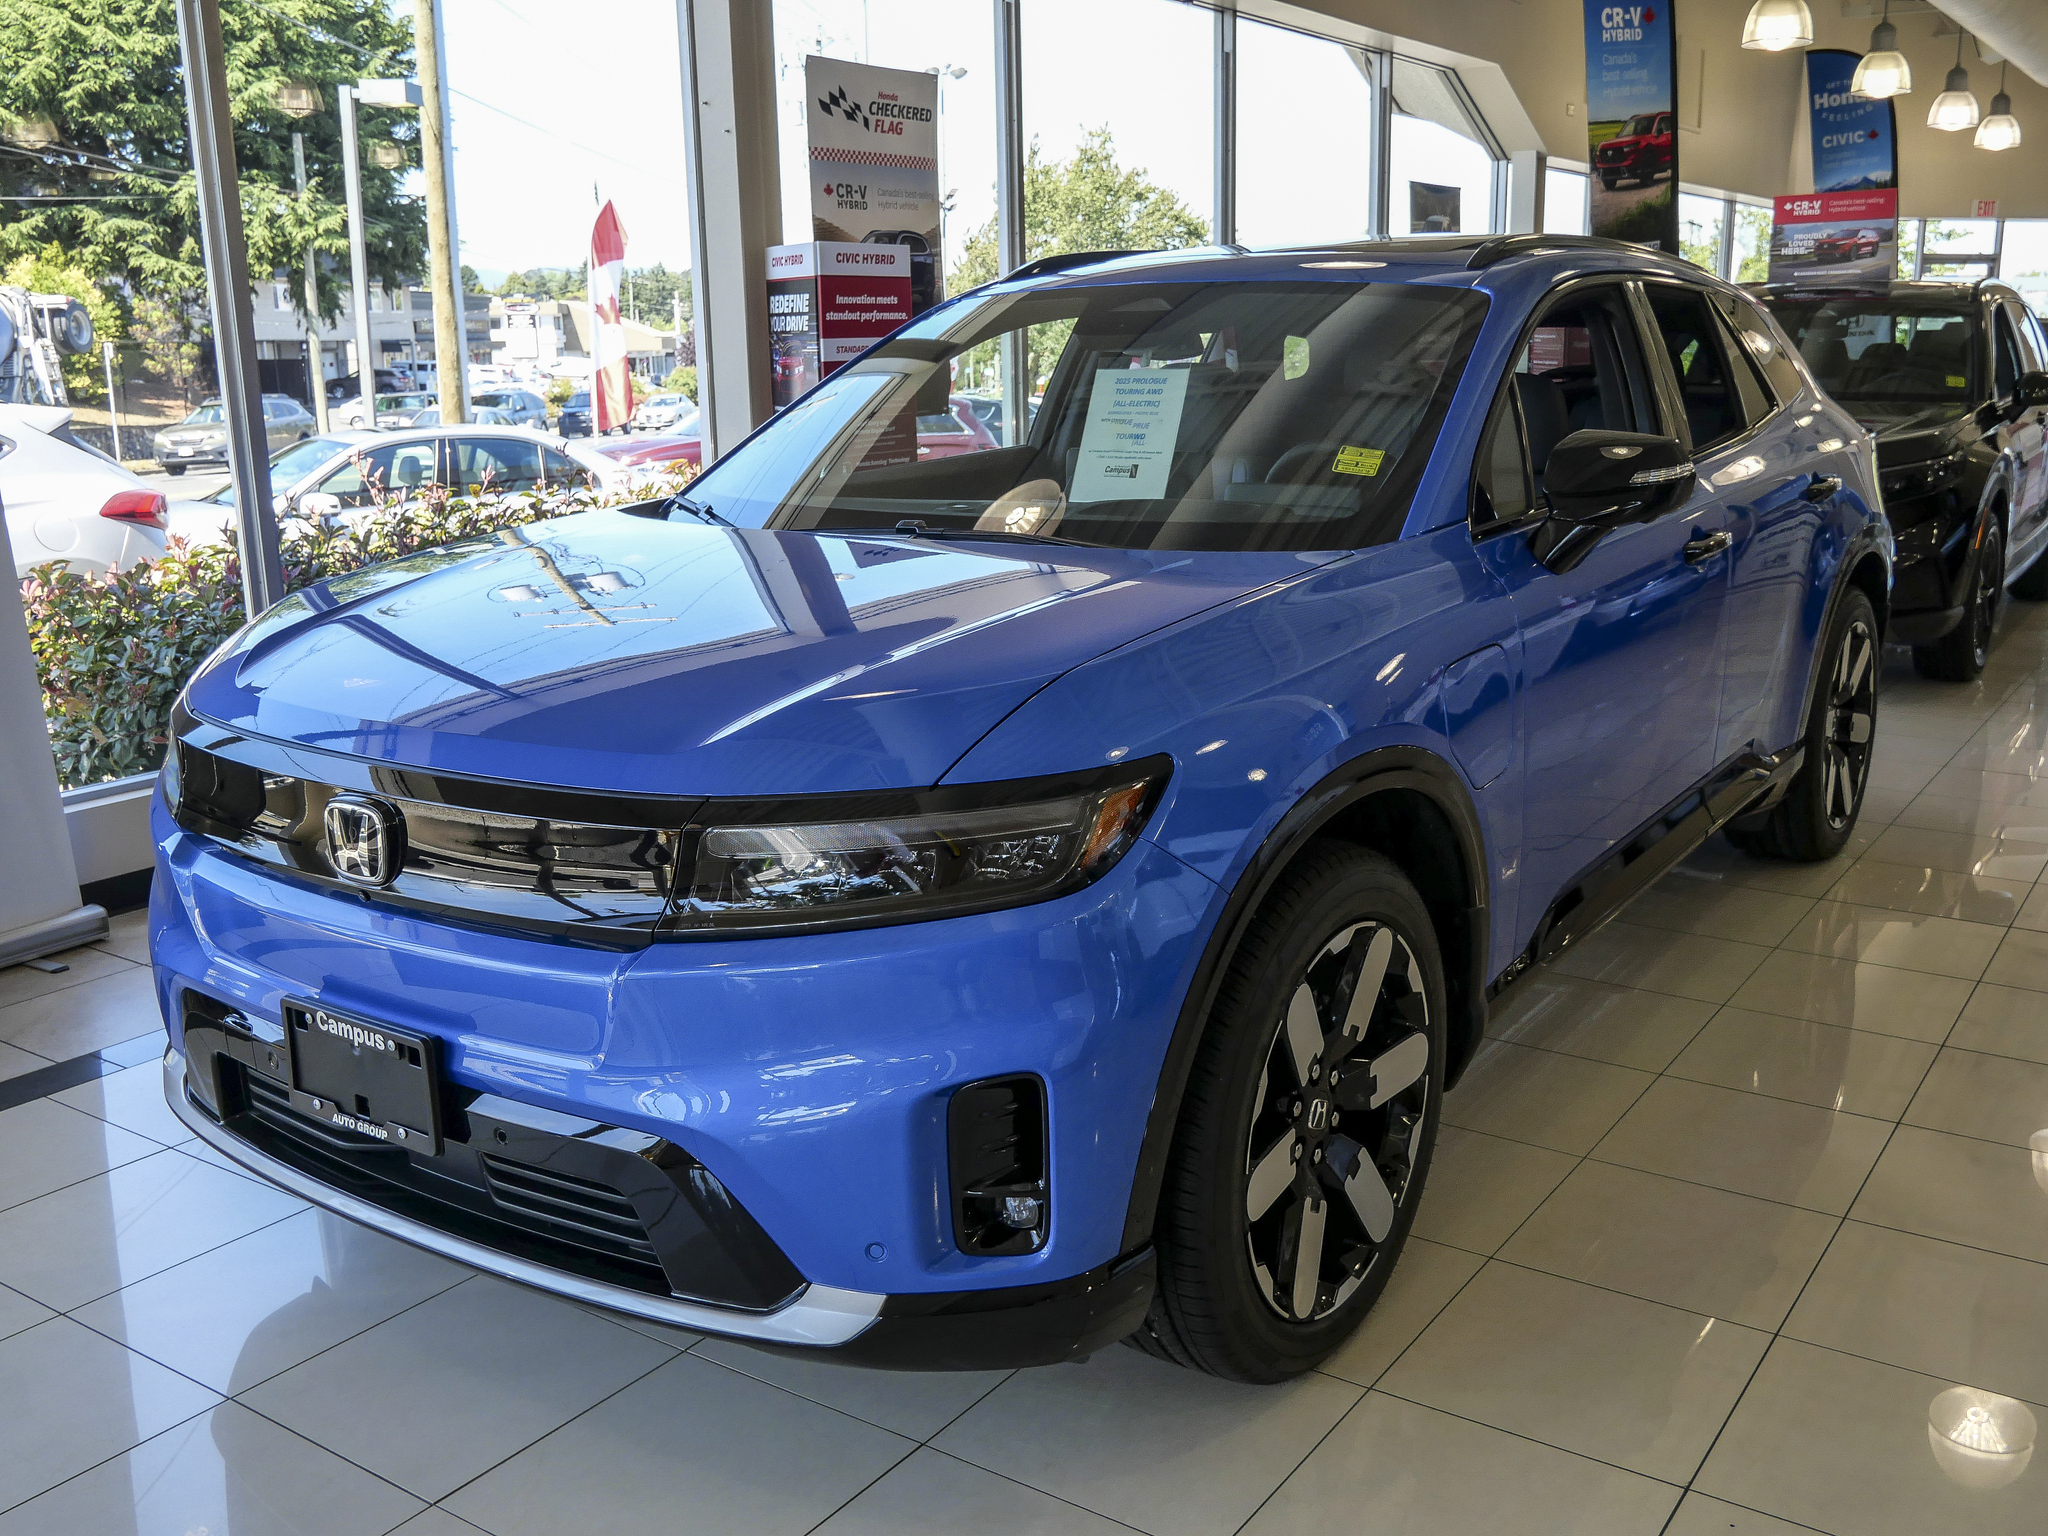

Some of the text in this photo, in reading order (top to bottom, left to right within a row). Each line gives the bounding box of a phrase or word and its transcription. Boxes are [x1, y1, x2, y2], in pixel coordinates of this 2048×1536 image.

[1601, 7, 1641, 28] CR-V
[1602, 28, 1643, 42] HYBRID
[878, 91, 899, 101] Honda
[869, 101, 932, 123] CHECKERED
[874, 119, 904, 135] FLAG
[1822, 130, 1865, 148] CIVIC
[836, 183, 867, 199] CR-V
[837, 199, 868, 210] HYBRID
[1793, 201, 1821, 210] CR-V
[1977, 201, 1996, 216] EXIT
[772, 254, 804, 267] CIVIC HYBRID
[836, 252, 896, 265] CIVIC HYBRID
[770, 293, 809, 313] REDEFINE
[836, 294, 898, 304] Innovation meets
[825, 310, 909, 322] standout performance.
[770, 315, 809, 332] YOUR DRIVE
[836, 345, 869, 354] STANDAR
[1112, 400, 1161, 408] (ALL-ELECTRIC)
[1105, 465, 1130, 474] Campus
[316, 1011, 386, 1050] Campus
[332, 1113, 388, 1139] AUTO GROUP
